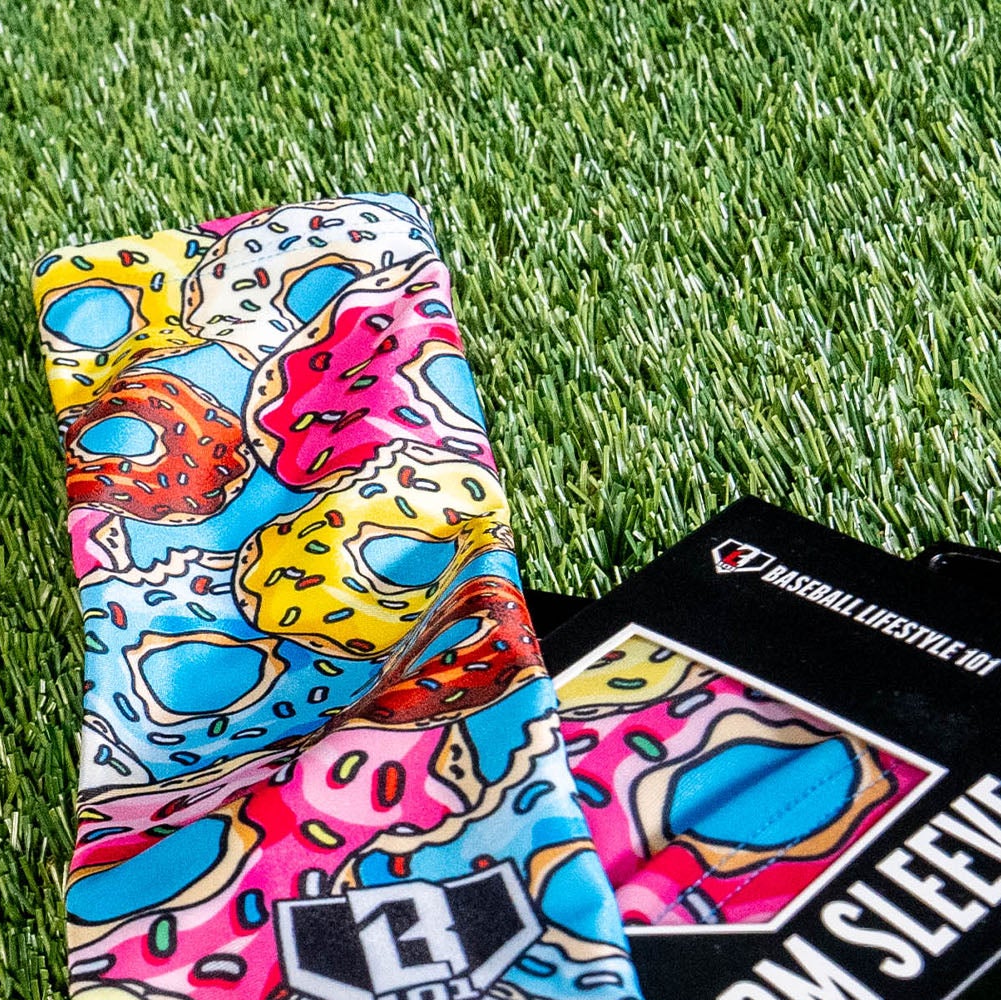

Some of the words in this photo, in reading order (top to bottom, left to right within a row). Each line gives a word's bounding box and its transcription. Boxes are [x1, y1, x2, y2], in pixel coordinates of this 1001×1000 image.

[761, 564, 864, 617] BASEBALL
[853, 604, 966, 660] LIFESTYLE
[954, 648, 1001, 677] 101
